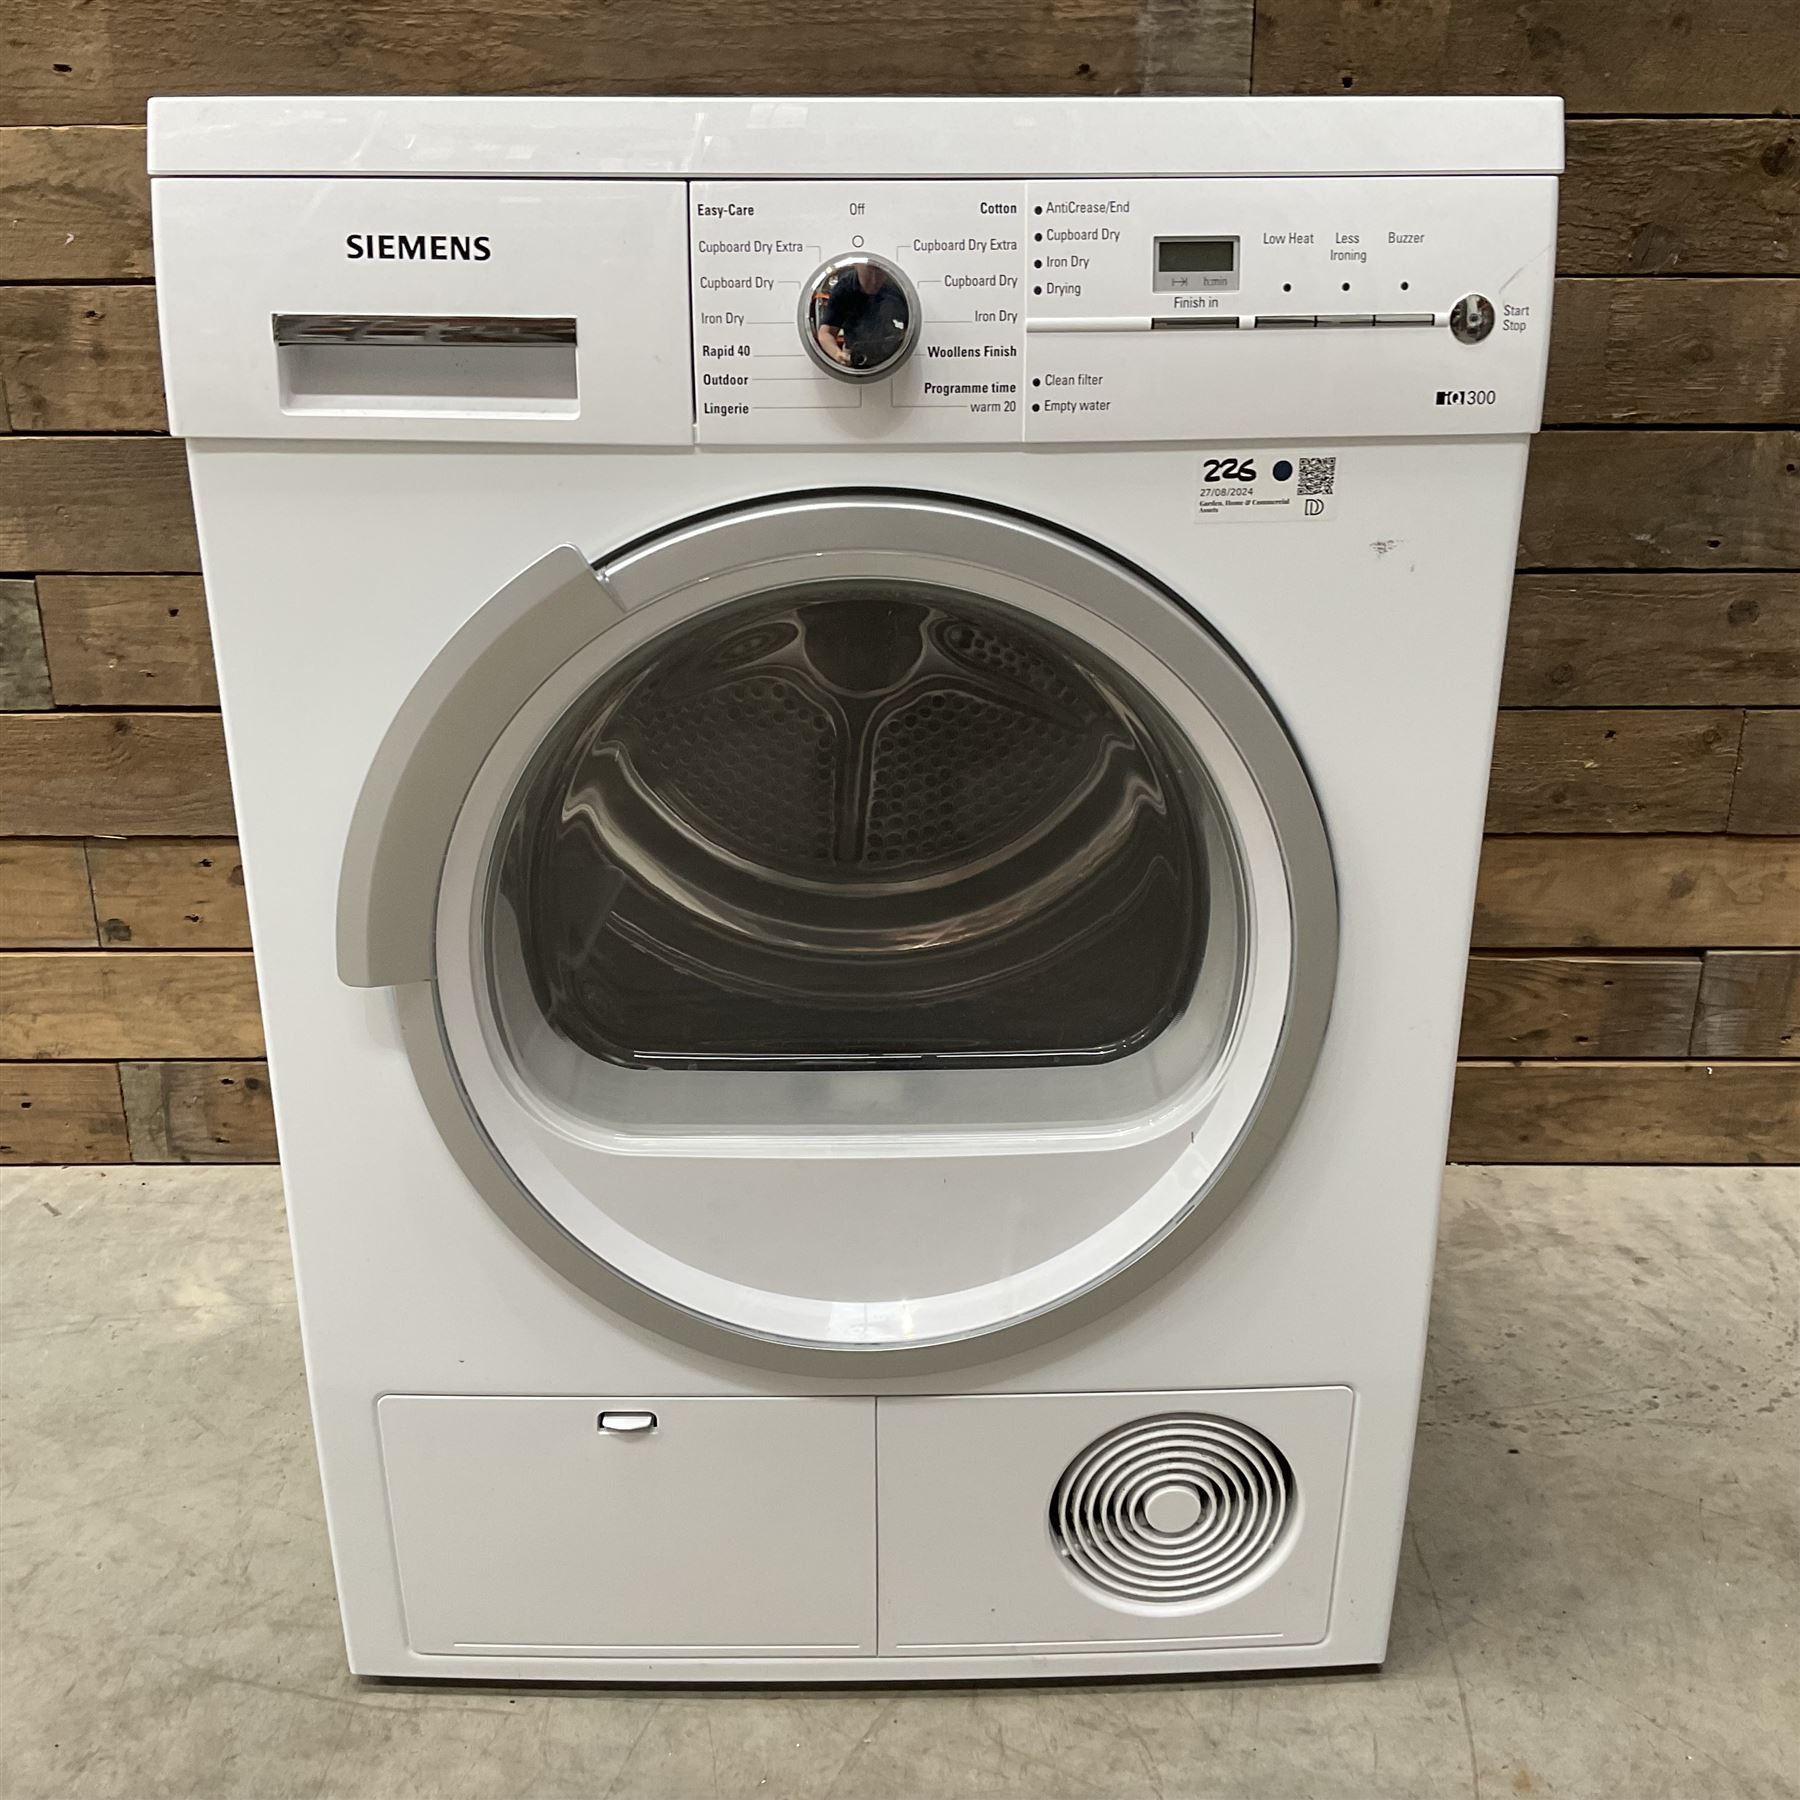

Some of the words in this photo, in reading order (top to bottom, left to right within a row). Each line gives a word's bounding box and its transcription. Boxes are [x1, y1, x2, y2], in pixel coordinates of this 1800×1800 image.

[697, 204, 754, 217] Easy-Care
[849, 204, 865, 215] Off
[980, 203, 1017, 215] Cotton
[1046, 201, 1130, 214] AntiCrease/End
[1046, 229, 1098, 242] Cupboard
[1102, 229, 1120, 242] Dry
[1264, 233, 1285, 244] Low
[1288, 233, 1314, 244] Heat
[1336, 233, 1360, 244] Less
[1388, 232, 1424, 244] Buzzer
[347, 234, 491, 261] SIEMENS
[699, 241, 754, 254] Cupboard
[758, 241, 774, 254] Dry
[776, 241, 803, 252] Extra
[913, 240, 967, 252] Cupboard
[969, 240, 987, 252] Dry
[990, 240, 1017, 250] Extra
[1330, 250, 1367, 262] Ironing
[1046, 256, 1067, 267] Iron
[1071, 256, 1089, 269] Dry
[700, 277, 753, 290] Cupboard
[756, 277, 774, 290] Dry
[944, 276, 997, 288] Cupboard
[1000, 276, 1017, 288] Dry
[1046, 283, 1081, 296] Drying
[1174, 297, 1206, 308] Finish
[1209, 297, 1218, 308] in
[975, 311, 996, 321] Iron
[999, 311, 1017, 323] Dry
[1504, 306, 1530, 316] Start
[701, 313, 724, 324] Iron
[726, 313, 744, 325] Dry
[1503, 321, 1526, 332] Stop
[702, 346, 735, 360] Rapid
[737, 346, 750, 356] 40
[927, 346, 982, 358] Woollens
[985, 346, 1017, 357] Finish
[703, 375, 749, 386] Outdoor
[1045, 374, 1075, 386] Clean
[1078, 374, 1103, 385] filter
[924, 382, 989, 396] Programme
[992, 382, 1016, 393] time
[704, 403, 749, 417] Lingerie
[970, 402, 1001, 412] warm
[1004, 401, 1017, 412] 20
[1044, 400, 1077, 413] Empty
[1079, 401, 1111, 411] water
[1203, 458, 1257, 482] 226
[1200, 488, 1253, 497] 27/08/2024
